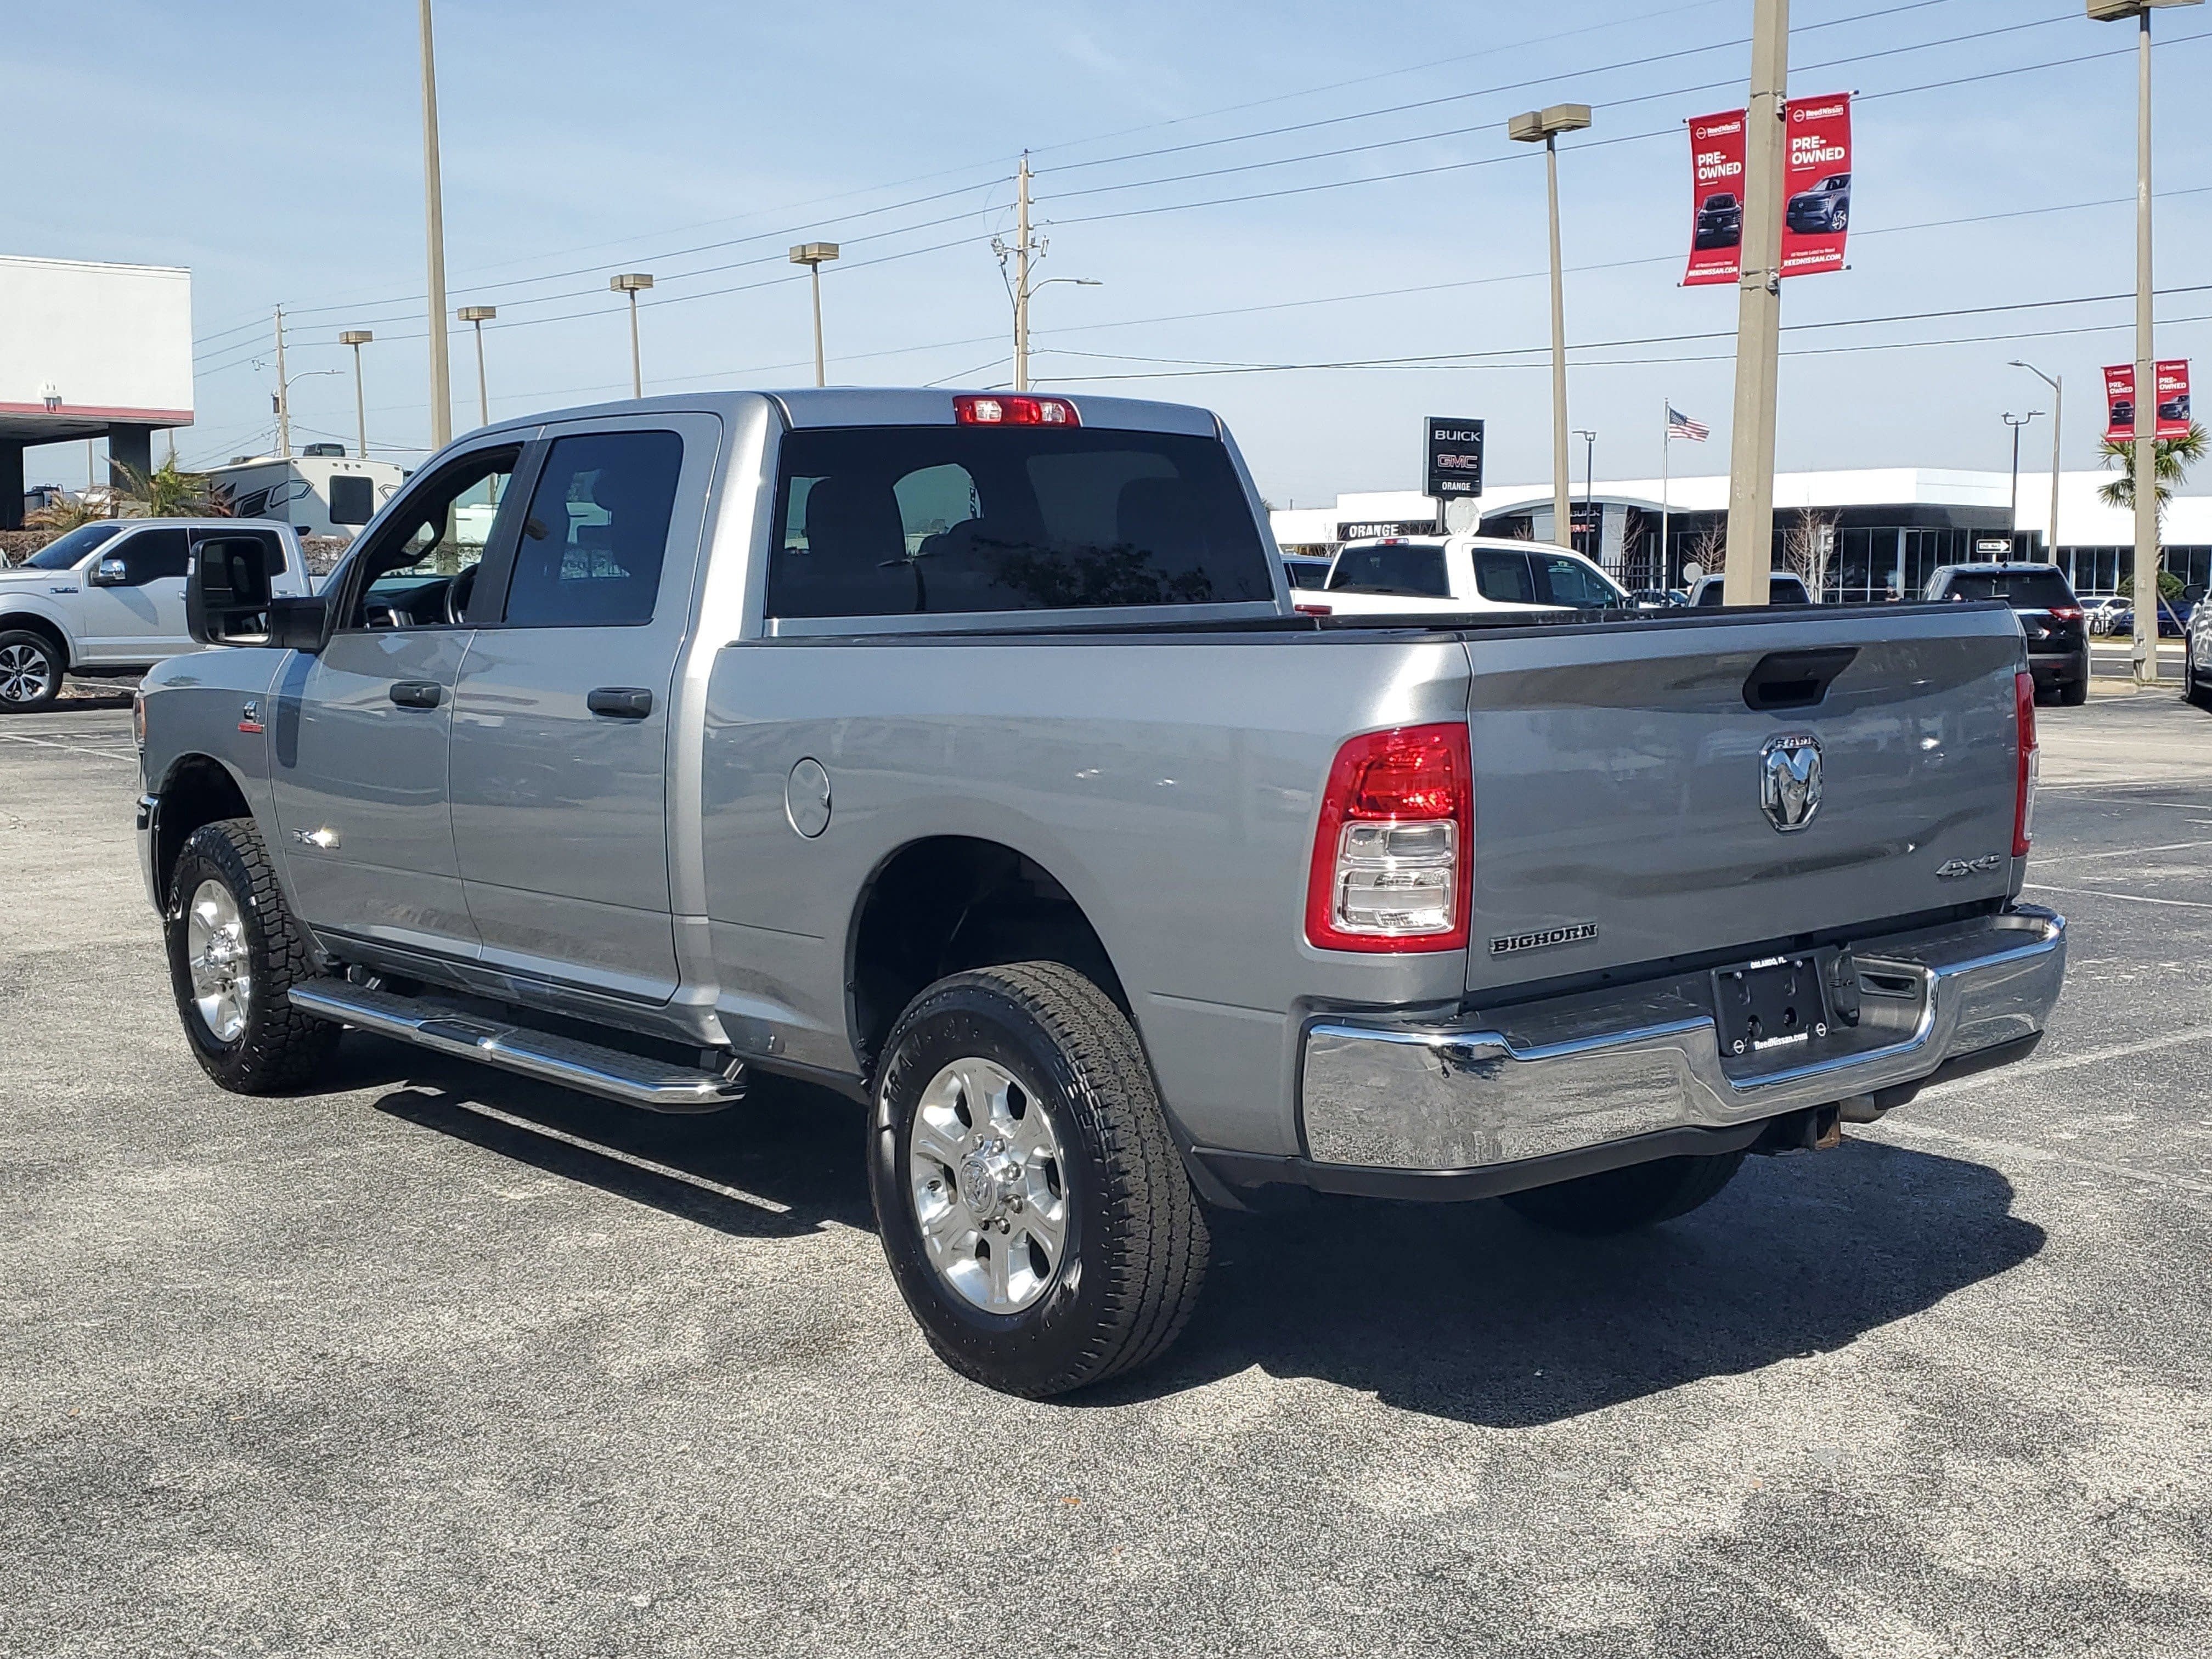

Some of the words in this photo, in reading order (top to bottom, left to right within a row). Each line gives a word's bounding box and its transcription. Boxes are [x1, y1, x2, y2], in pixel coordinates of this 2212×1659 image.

[1791, 136, 1827, 151] PRE-
[1697, 151, 1727, 167] PRE-
[1791, 146, 1846, 165] OWNED
[1698, 162, 1742, 180] OWNED
[1784, 253, 1841, 267] REEDNISSAN.COM
[2109, 386, 2134, 394] OWNED
[1435, 430, 1481, 442] BUICK
[1437, 454, 1478, 469] GMC
[1442, 481, 1471, 491] ORANGE
[1349, 524, 1399, 538] ORANGE
[1490, 923, 1598, 955] BIGHORN
[1754, 1032, 1808, 1051] ReedNissan.com
